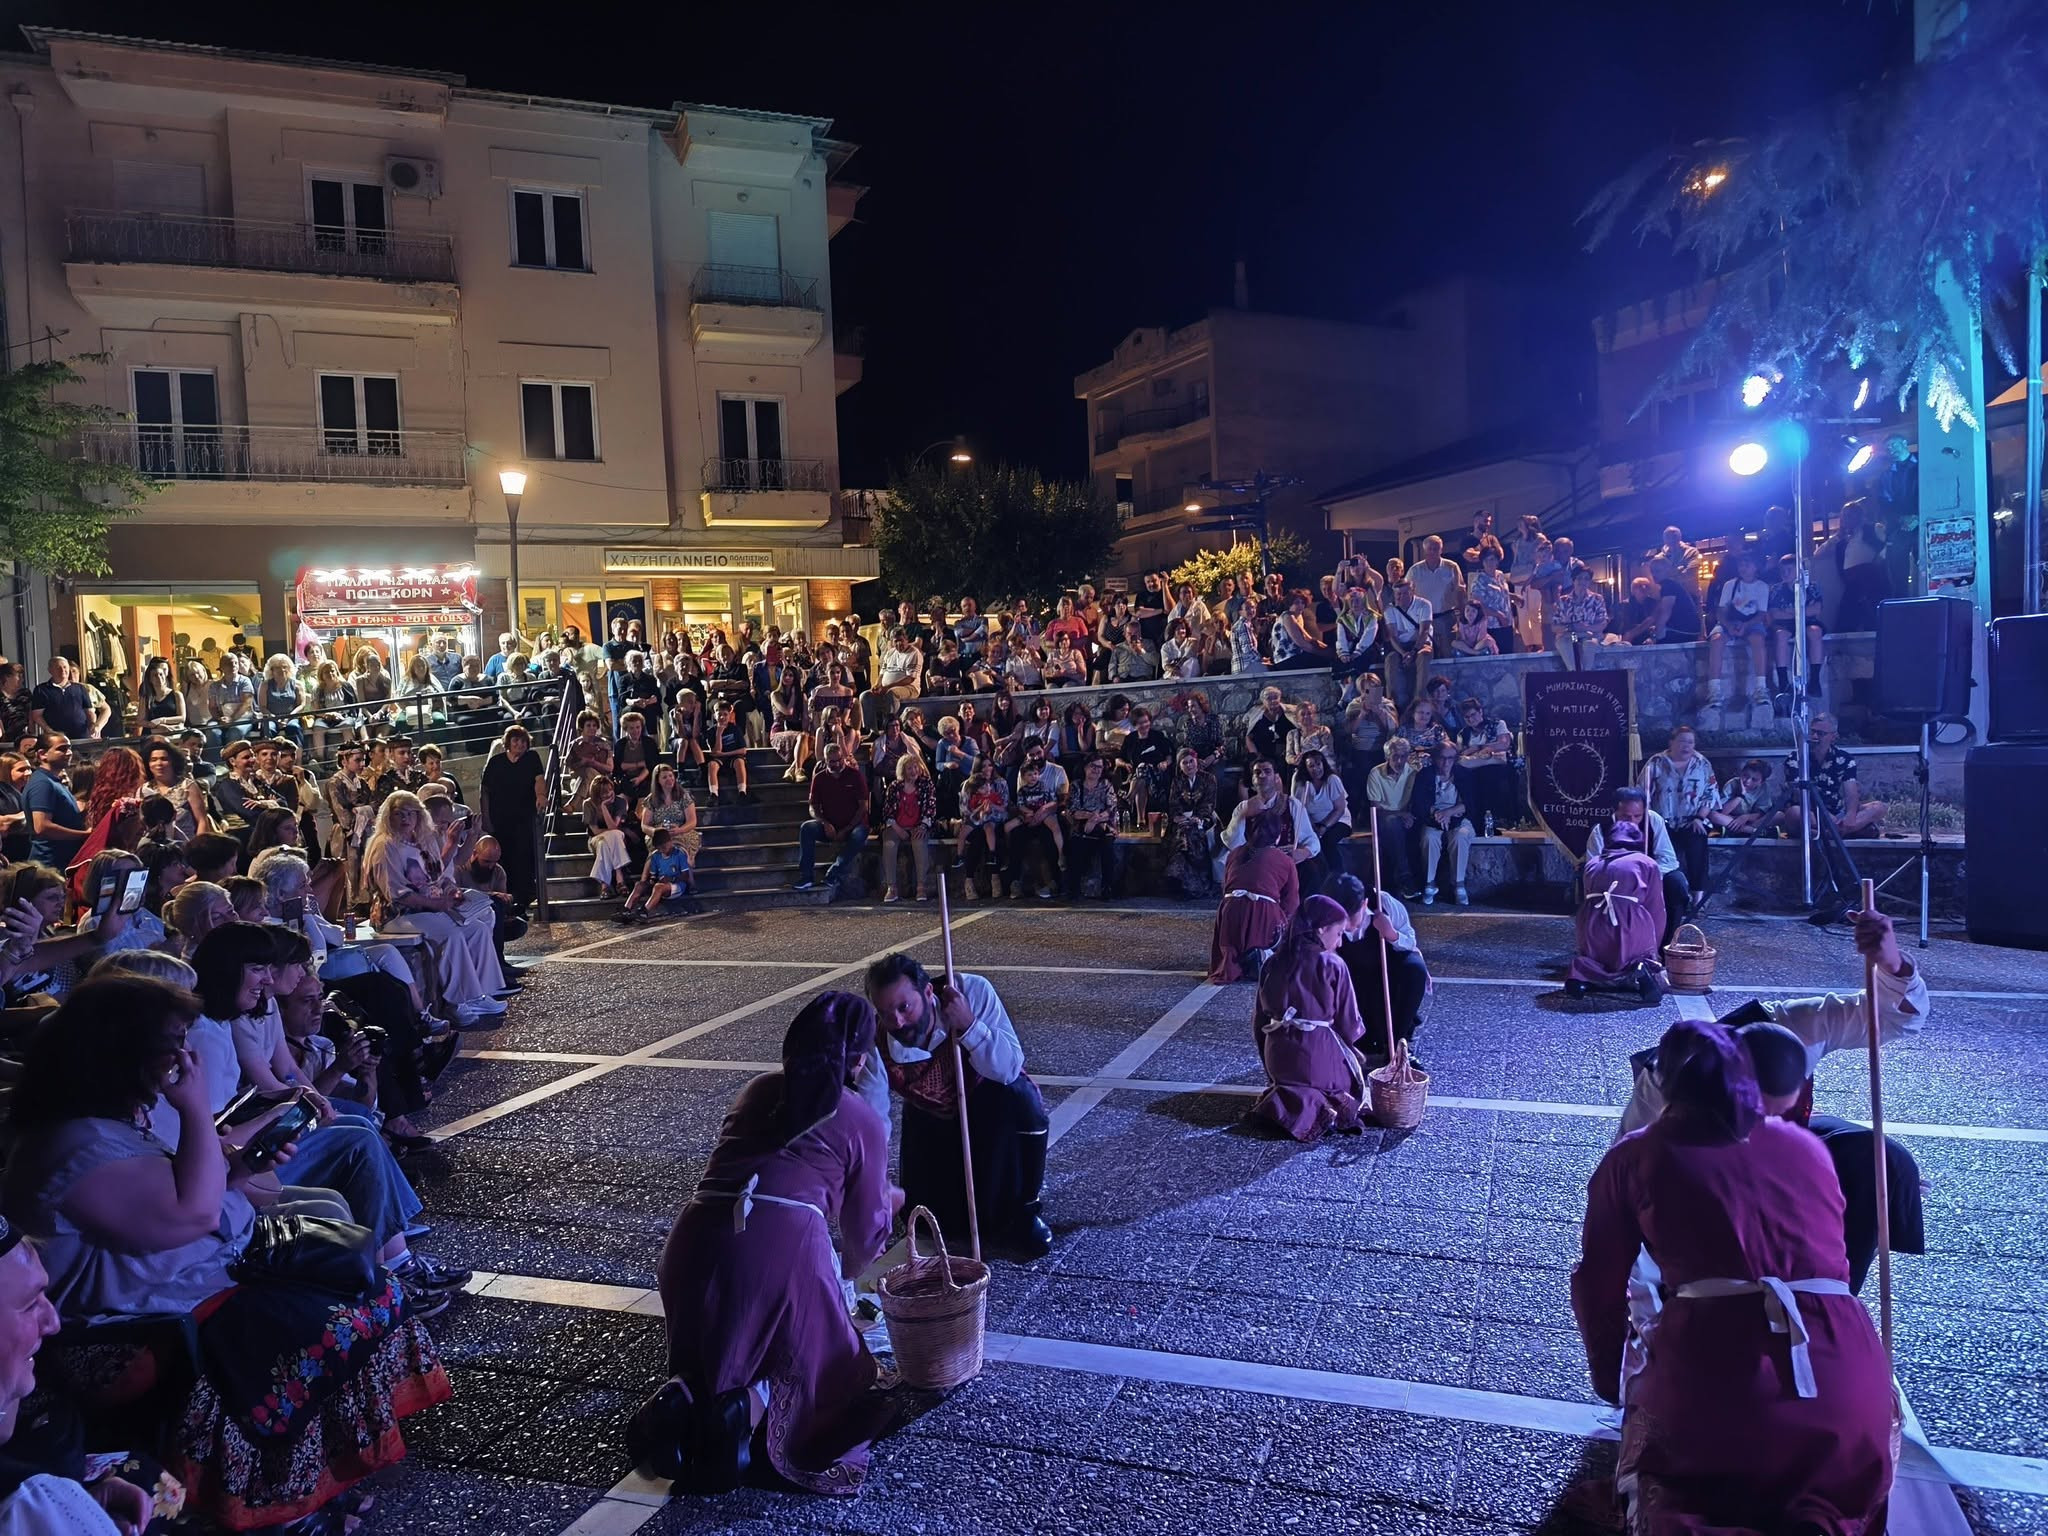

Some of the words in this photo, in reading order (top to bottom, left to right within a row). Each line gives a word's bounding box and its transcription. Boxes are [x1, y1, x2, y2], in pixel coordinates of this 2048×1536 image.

[610, 554, 728, 567] ΧΑΤΖΗΓΙΑΝΝΕΙΟ
[379, 575, 405, 587] ΤΗΣ
[409, 575, 449, 587] ΓΡΙΑΣ
[345, 589, 378, 600] ΠΟΠ
[390, 587, 433, 599] ΚΟΡΝ
[357, 615, 394, 624] FLOSS
[405, 615, 429, 624] POP
[433, 614, 465, 623] CORN
[1545, 728, 1567, 736] ΔΡΑ
[1543, 803, 1566, 815] ΕΤΟΣ
